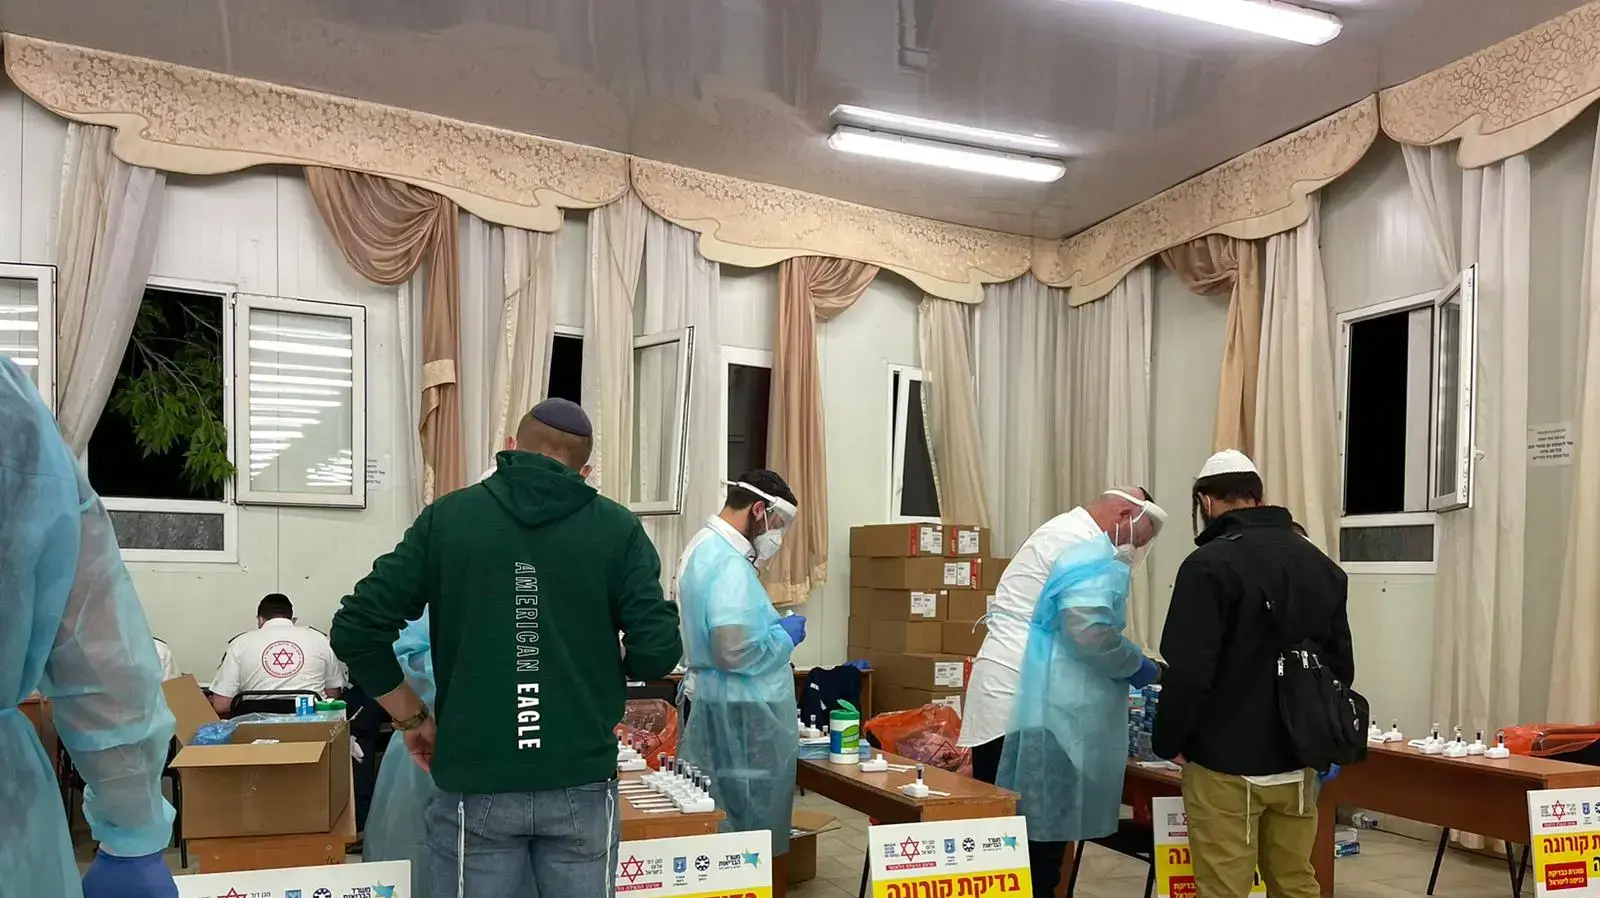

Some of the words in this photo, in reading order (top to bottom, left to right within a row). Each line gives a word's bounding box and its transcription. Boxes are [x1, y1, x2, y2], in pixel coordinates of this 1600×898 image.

[515, 562, 540, 672] AMERICAN
[517, 683, 541, 750] EAGLE
[1543, 835, 1589, 856] קורונה
[718, 859, 741, 867] הבריאות
[1168, 848, 1191, 865] נה
[887, 878, 953, 898] קורונה
[958, 872, 1020, 898] בדיקת
